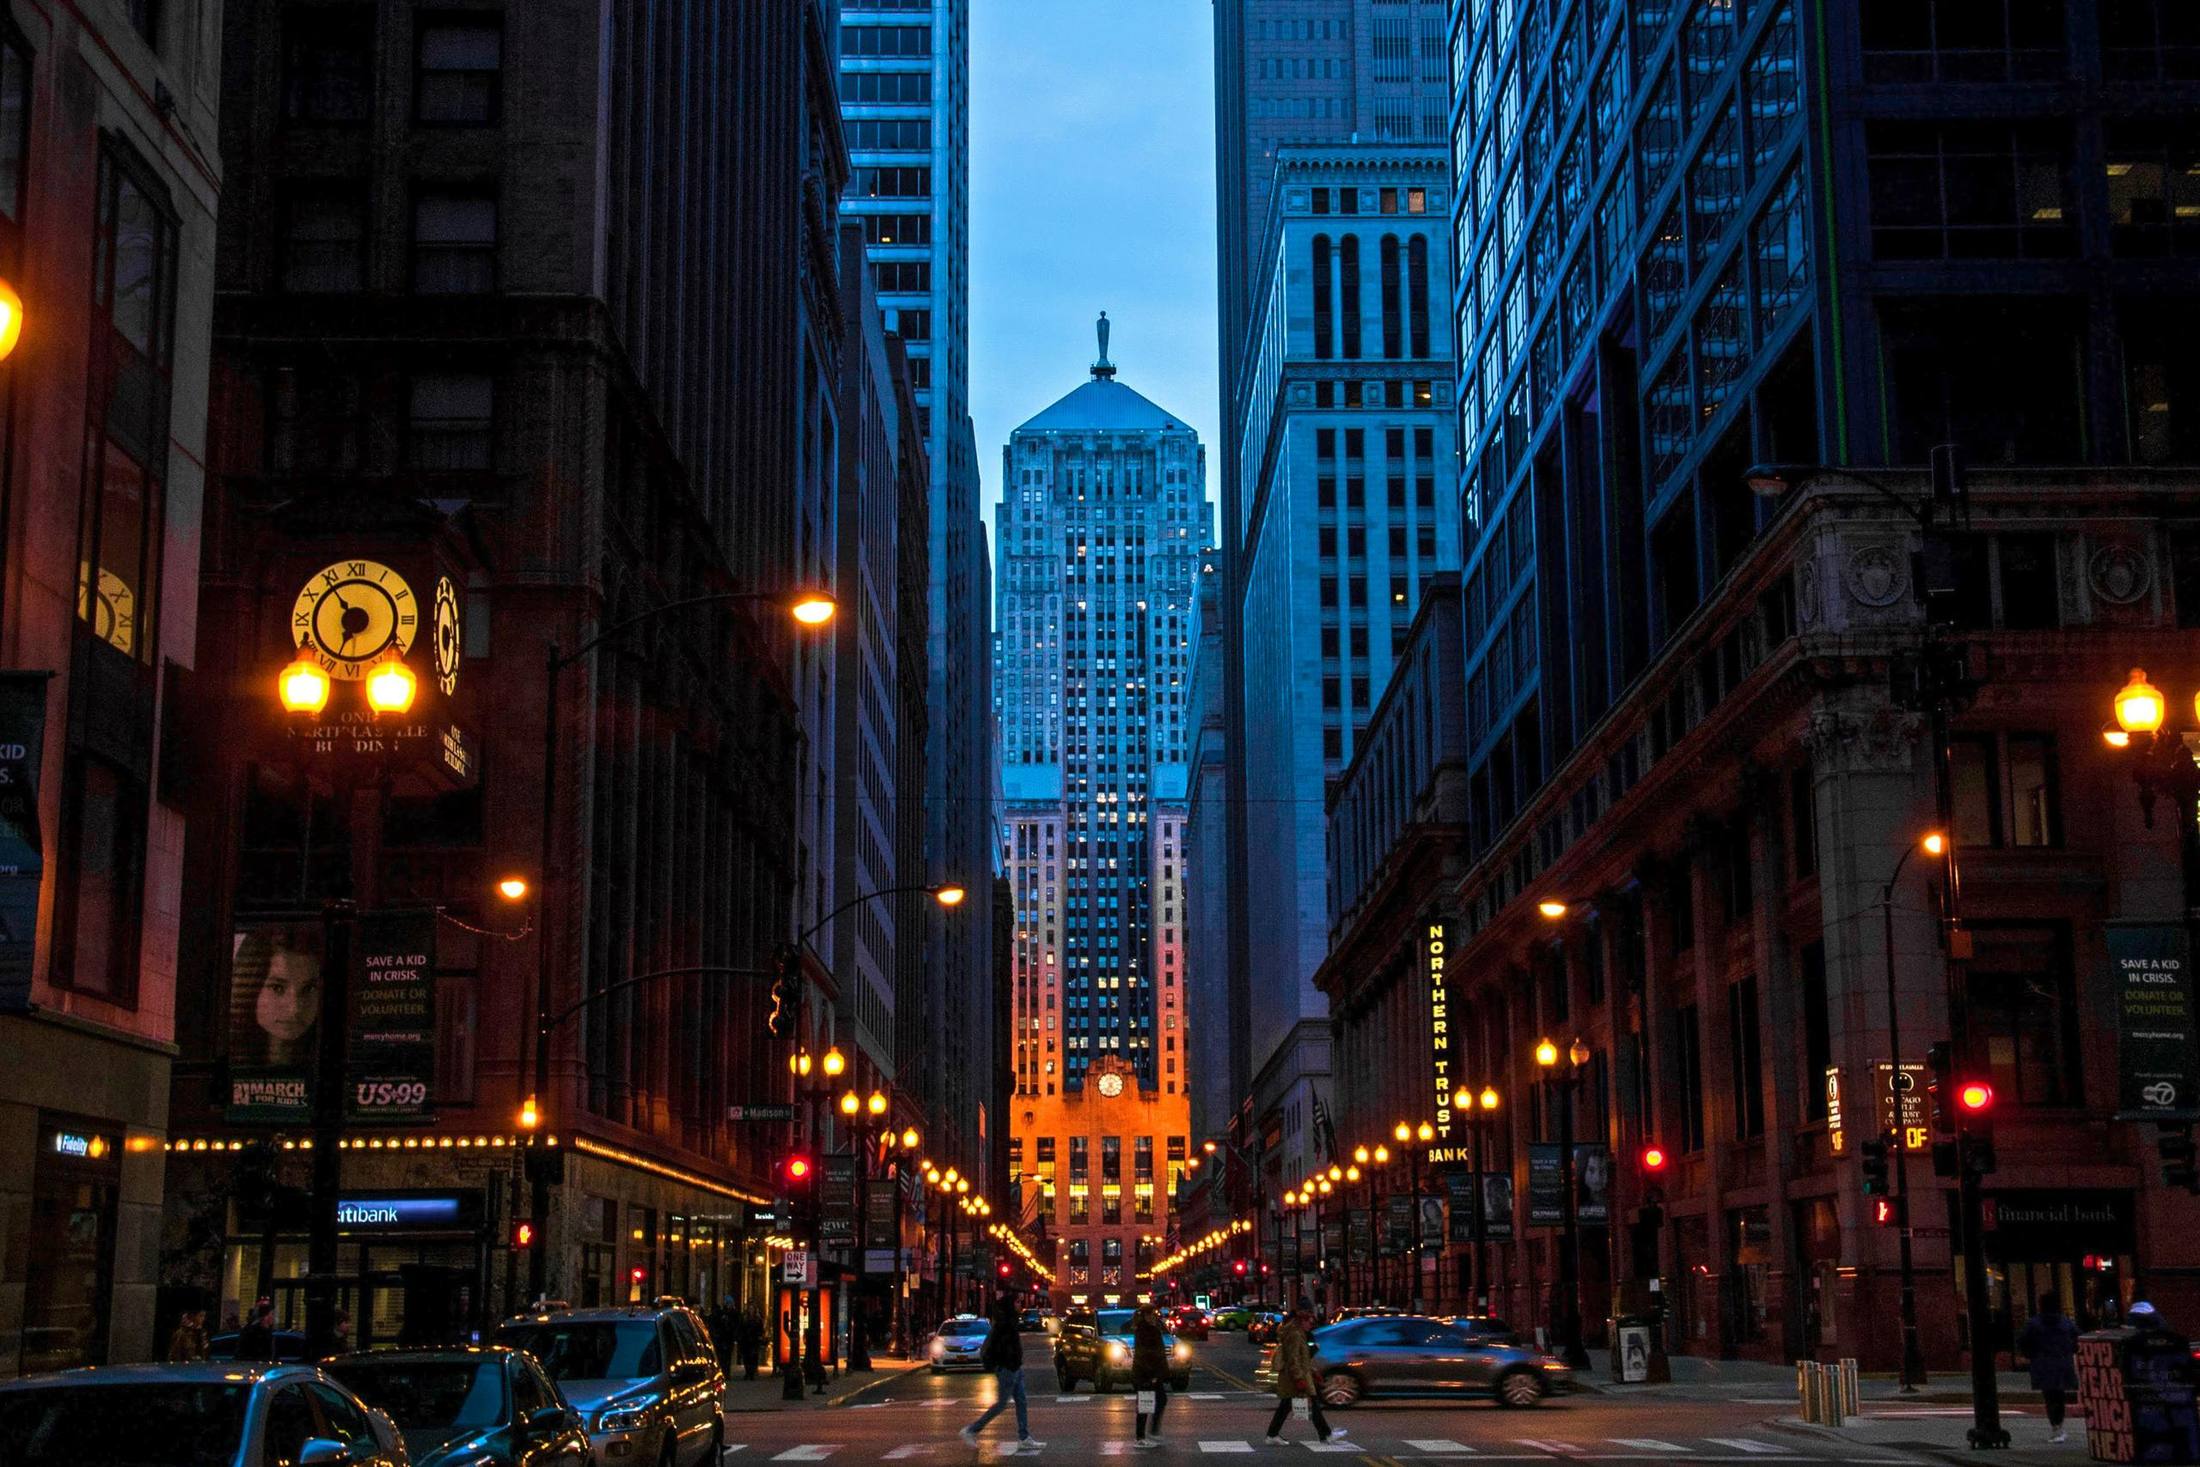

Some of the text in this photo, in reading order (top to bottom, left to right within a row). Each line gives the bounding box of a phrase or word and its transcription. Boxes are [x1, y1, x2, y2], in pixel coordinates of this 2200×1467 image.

[347, 563, 365, 576] XII
[302, 588, 319, 602] X
[401, 615, 415, 625] III
[366, 954, 427, 968] SAVE A KID
[2121, 960, 2180, 970] SAVE A KID
[370, 970, 420, 982] IN CRISIS.
[2128, 973, 2176, 984] IN CRISIS.
[1430, 925, 1450, 1138] NORTHERN TRUST
[1428, 1148, 1468, 1162] BANK
[786, 1253, 805, 1261] ONE
[786, 1262, 805, 1270] WAY
